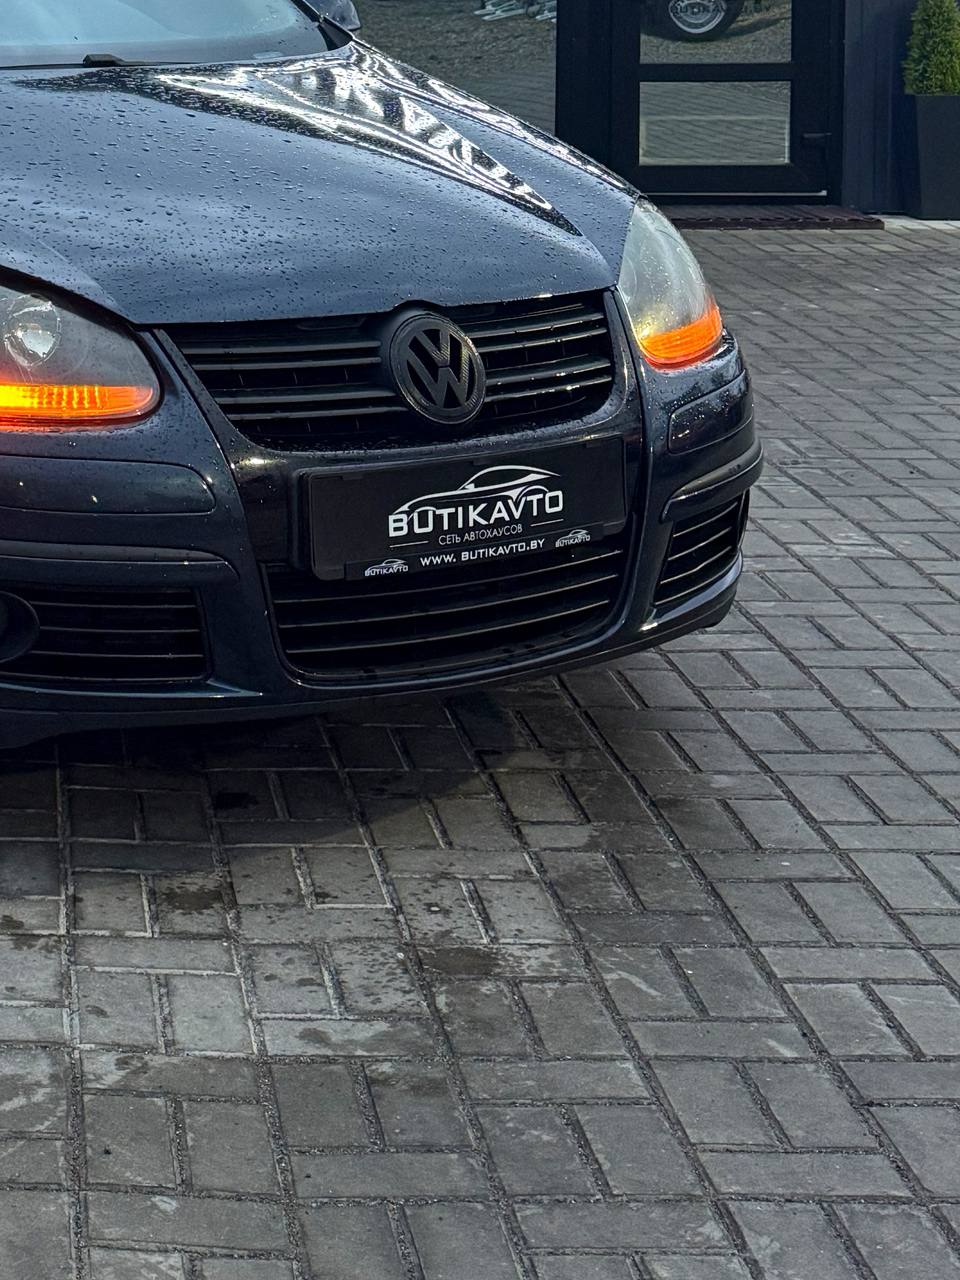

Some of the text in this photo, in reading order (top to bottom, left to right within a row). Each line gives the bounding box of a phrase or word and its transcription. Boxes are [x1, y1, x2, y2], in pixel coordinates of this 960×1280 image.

[388, 490, 564, 538] BUTIKAVTO
[438, 523, 523, 546] СЕТЬ АВТОХАУСОВ
[555, 535, 591, 548] BUTIKAVTO
[420, 538, 546, 567] WWW. BUTIKAVTO.BY
[364, 565, 409, 577] BUTIKAVTO
